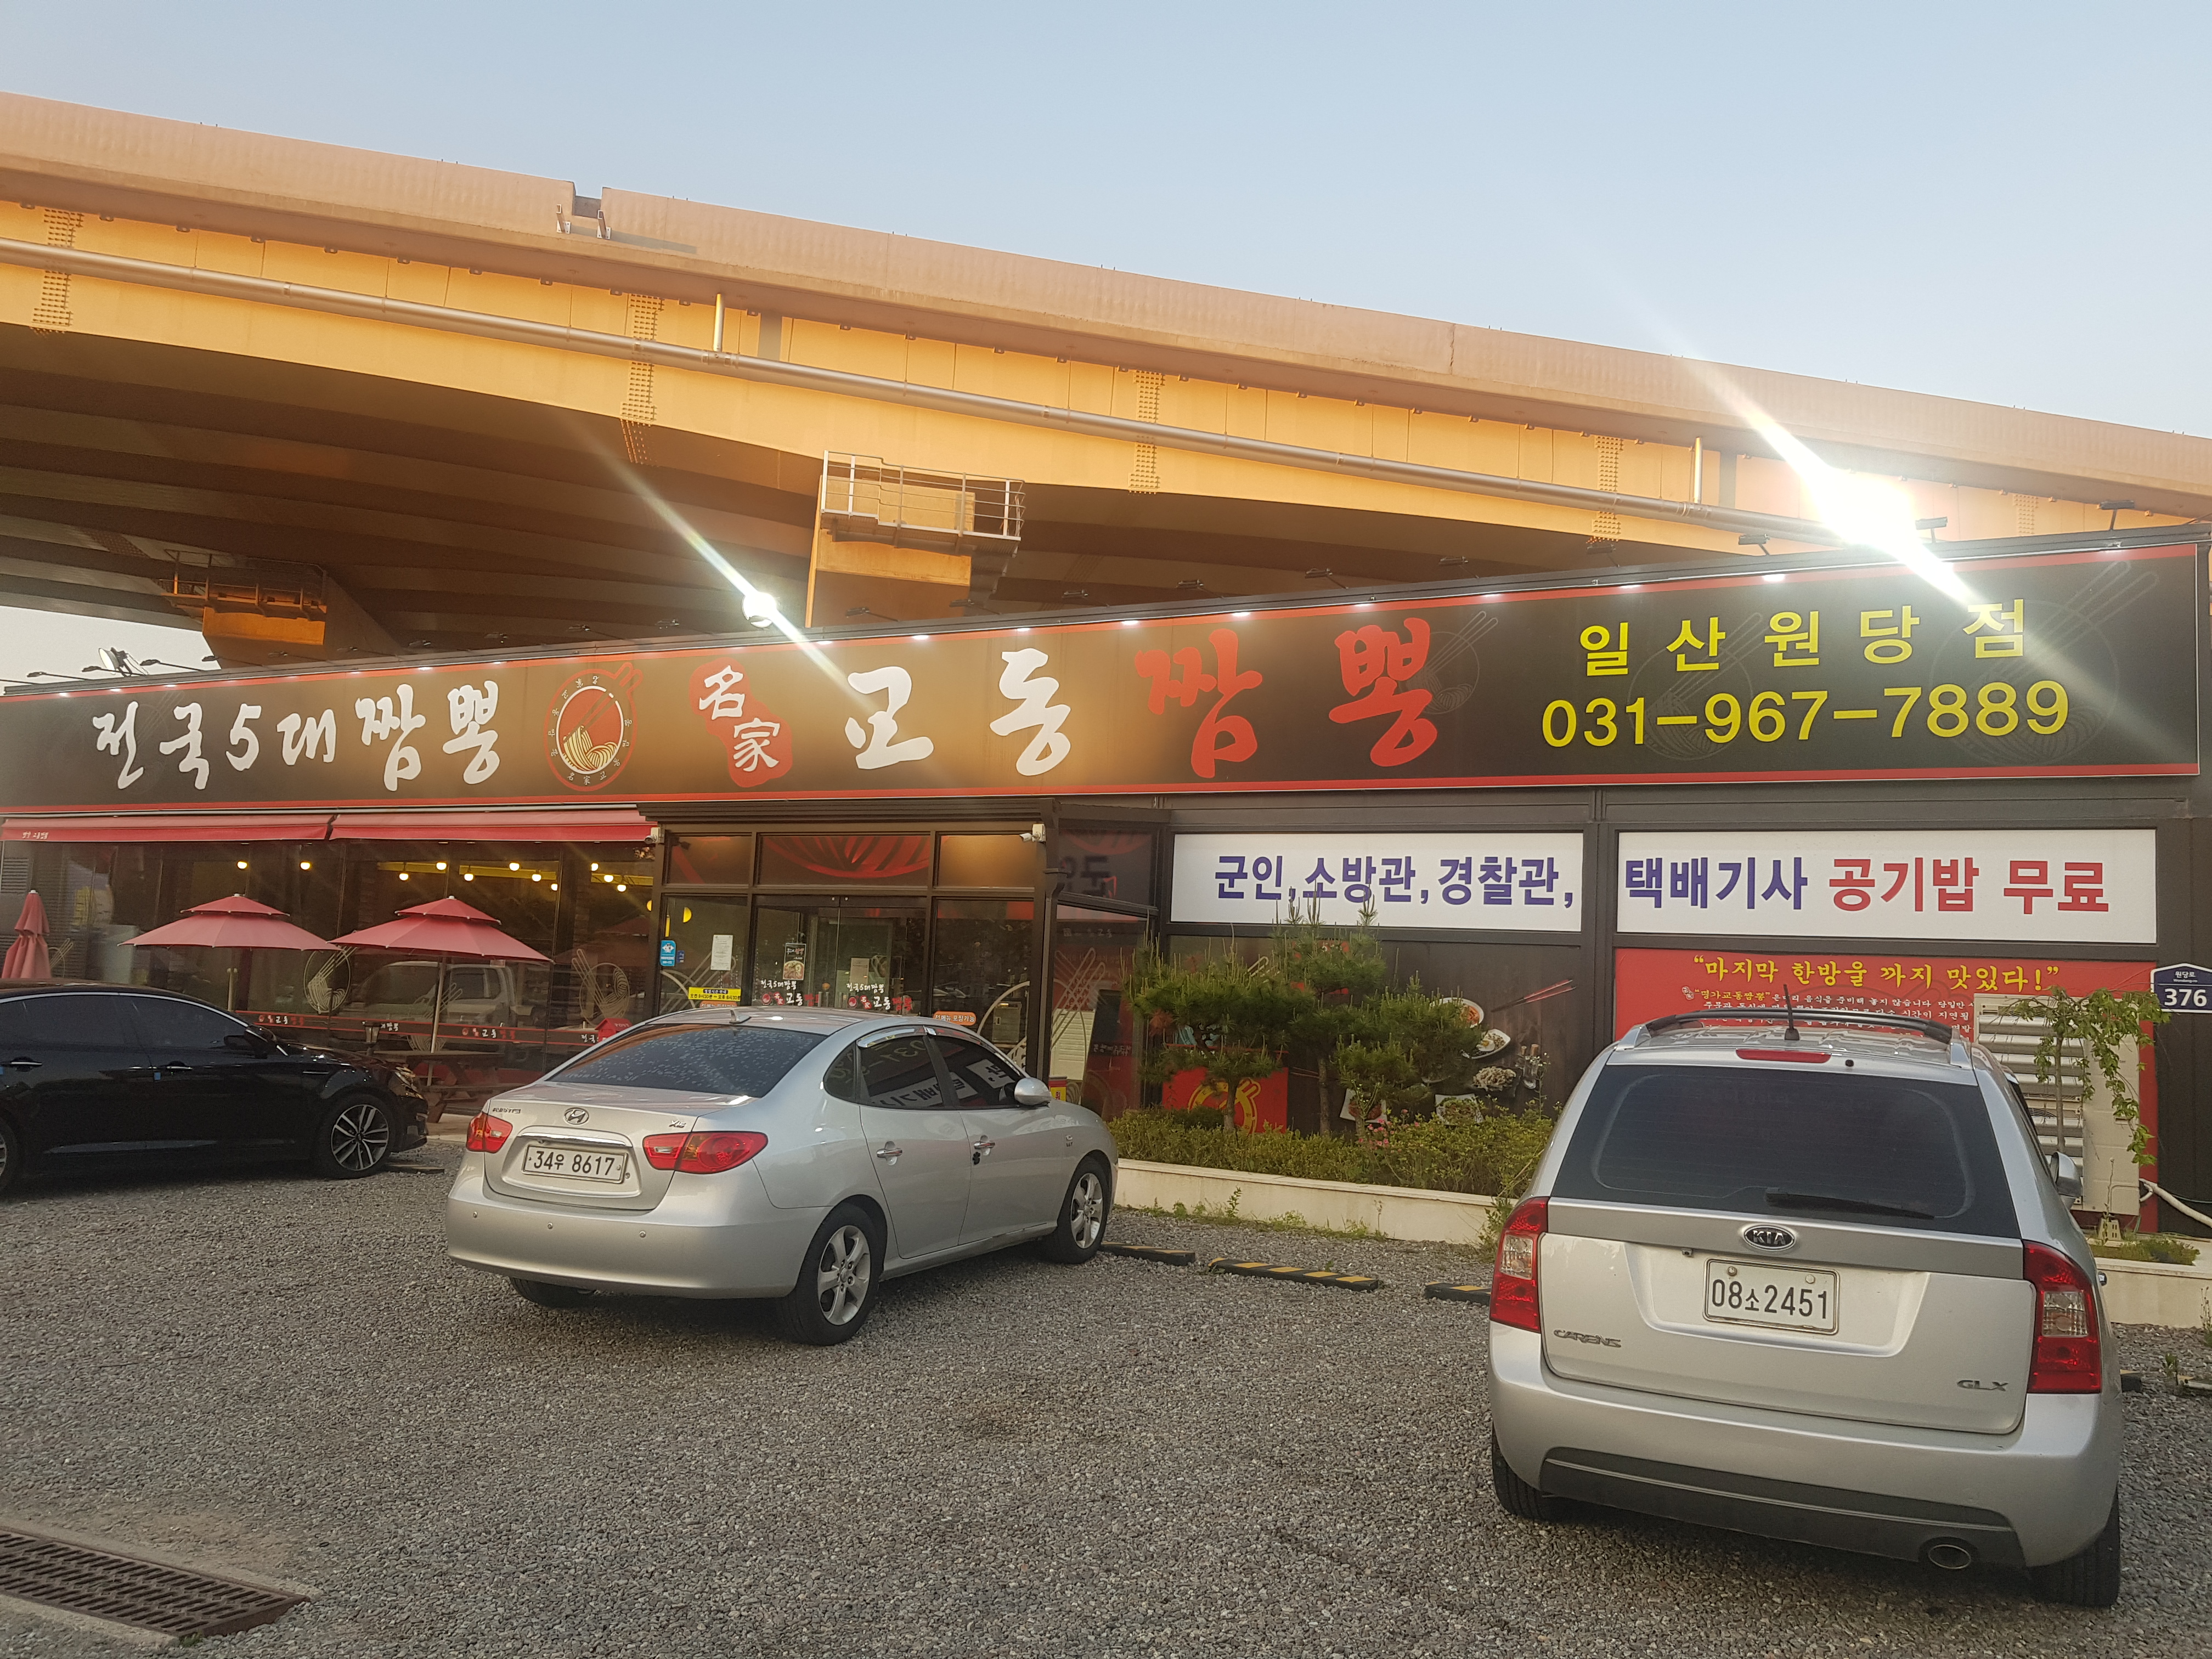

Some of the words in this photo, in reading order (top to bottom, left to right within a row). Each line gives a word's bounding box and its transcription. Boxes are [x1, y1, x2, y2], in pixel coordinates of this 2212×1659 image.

[1542, 680, 2069, 747] 031-967-7889
[1625, 857, 1808, 911] 택배기사
[1829, 857, 1979, 912] 공기밥
[2004, 860, 2110, 915] 무료
[1791, 961, 1867, 988] 한방울
[1880, 963, 1932, 989] 까지
[2175, 970, 2196, 979] 원당로
[1804, 995, 1832, 1005] 음식을
[2164, 988, 2207, 1007] 376
[1753, 1230, 1786, 1245] KIA
[1553, 1329, 1622, 1348] CARENS
[1957, 1380, 2008, 1392] GLX
